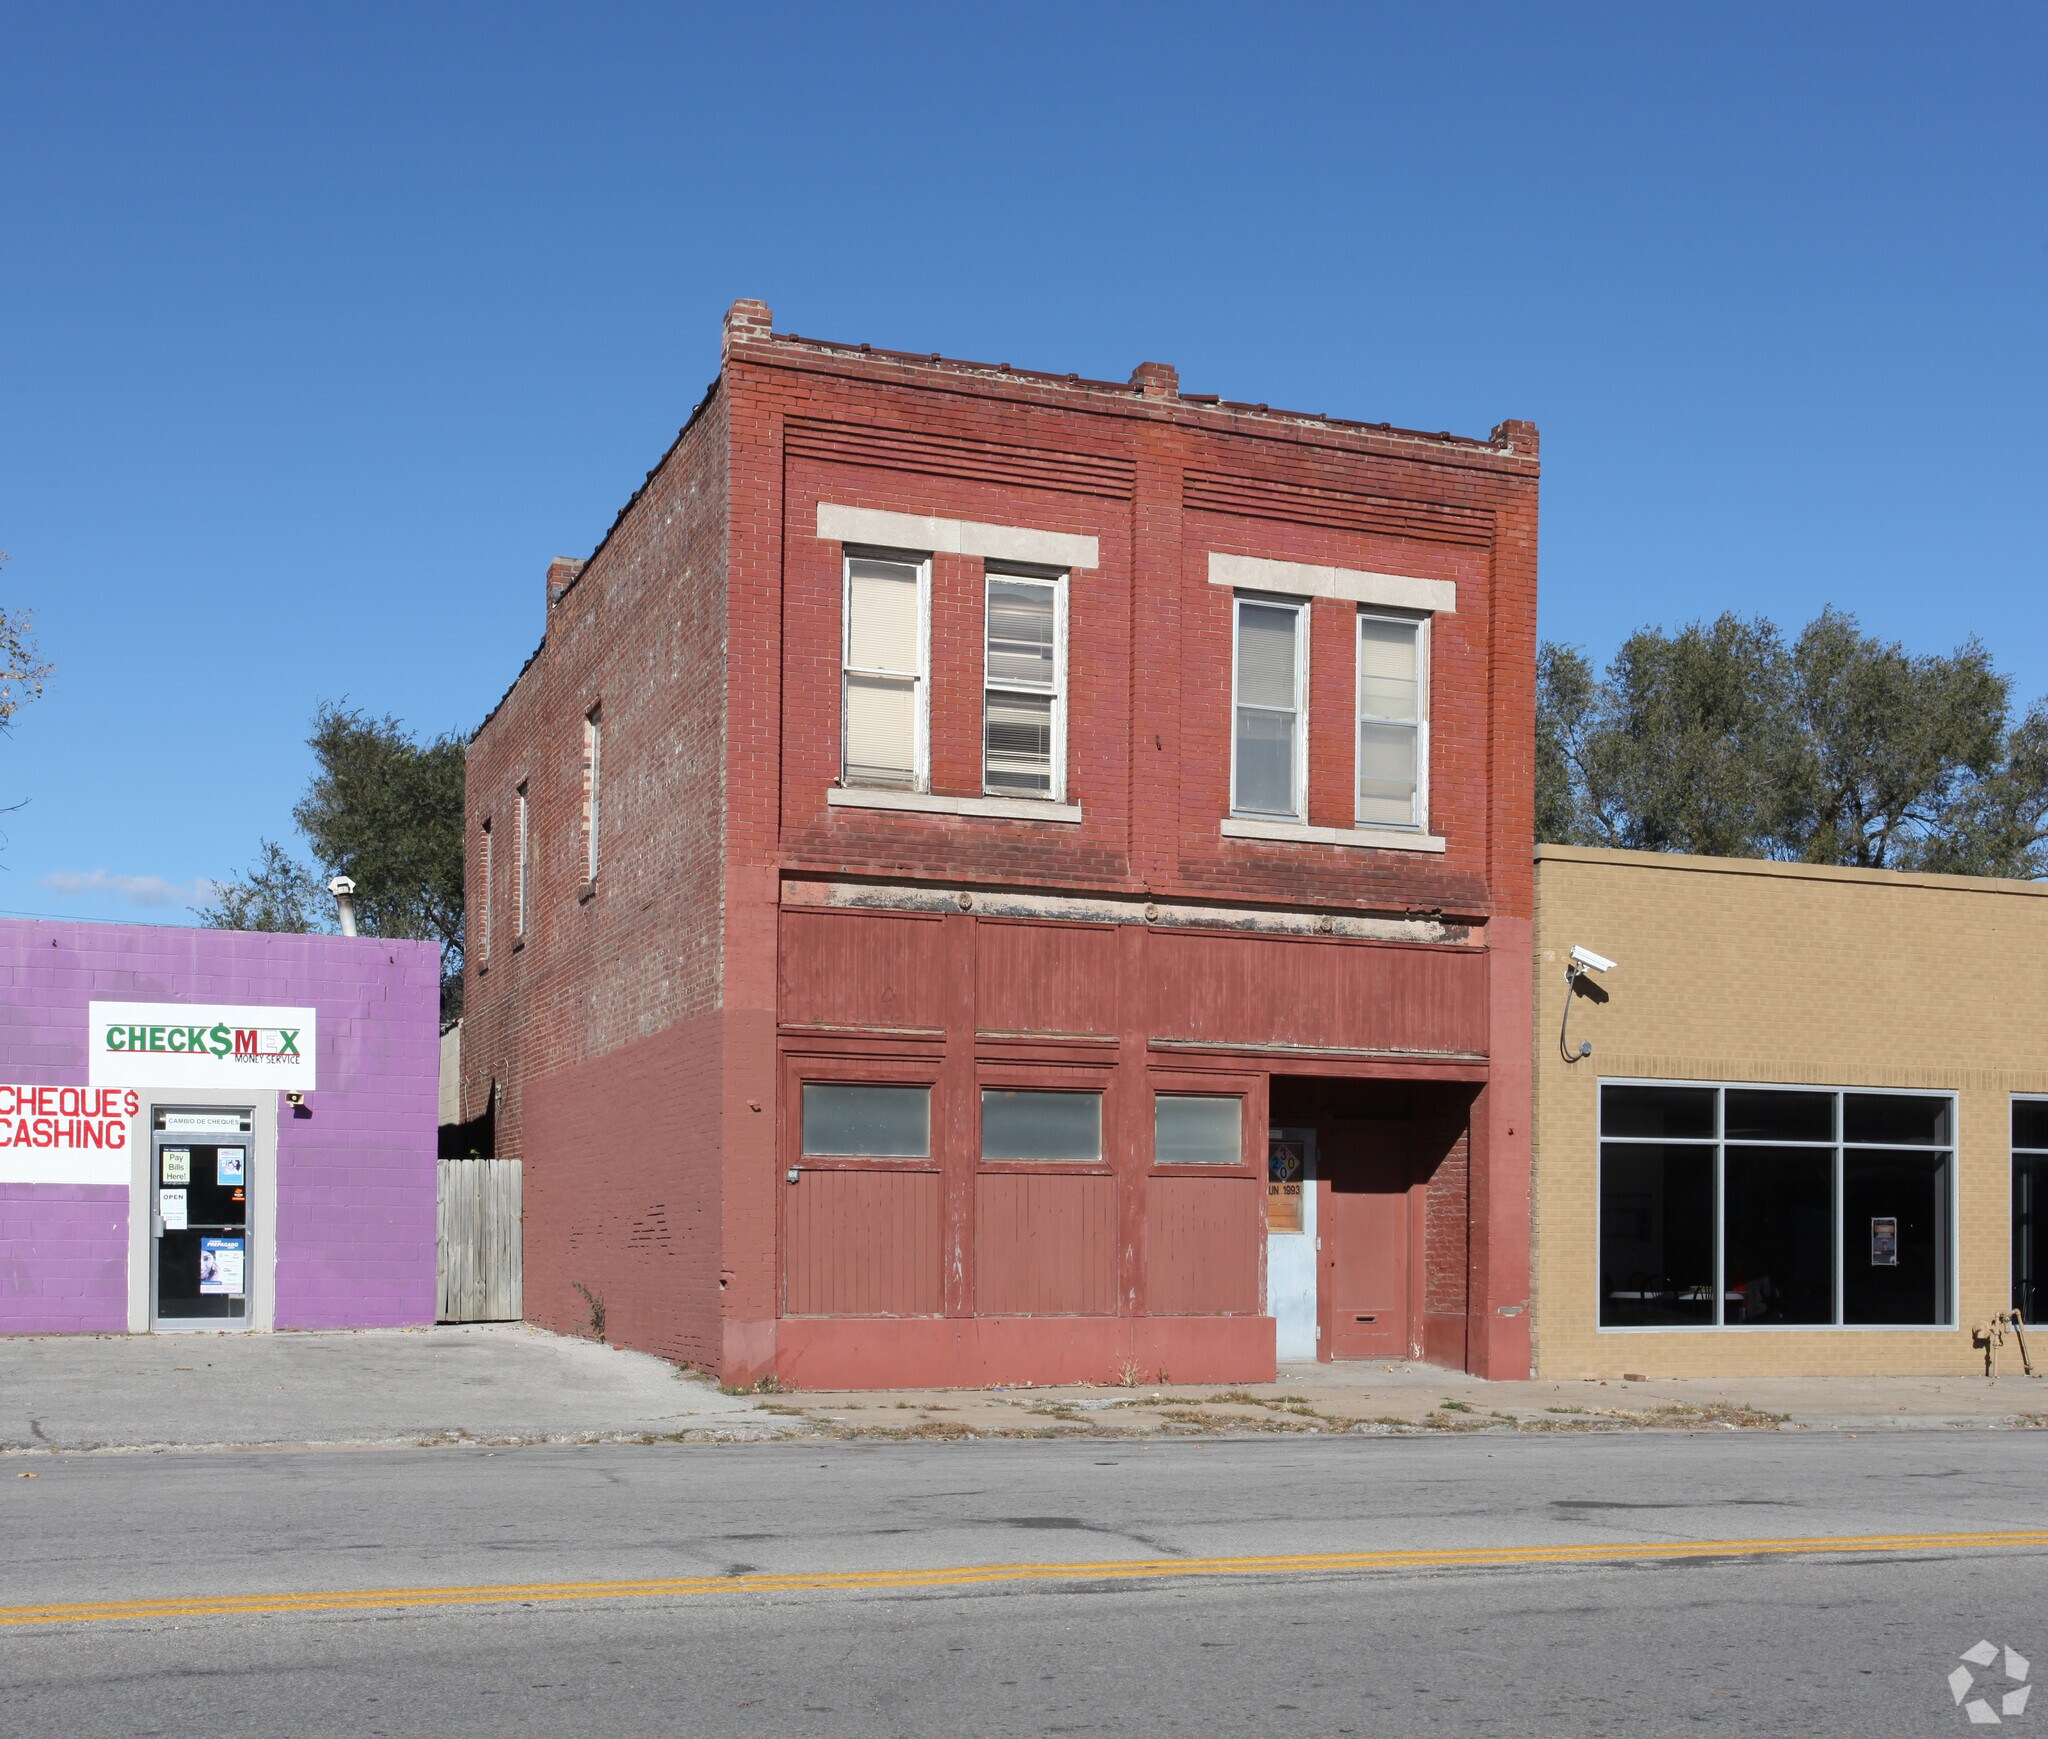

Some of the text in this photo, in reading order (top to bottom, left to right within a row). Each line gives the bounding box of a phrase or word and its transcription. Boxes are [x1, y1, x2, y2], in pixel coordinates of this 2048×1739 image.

[234, 1054, 300, 1064] MONEY SERVICE
[207, 1118, 240, 1126] CHEQUES
[0, 1118, 126, 1149] CASHING
[169, 1153, 184, 1162] Pay
[1280, 1149, 1287, 1161] 3
[169, 1163, 184, 1171] Bills
[1273, 1157, 1294, 1169] 2 0
[1280, 1166, 1287, 1179] 0
[1269, 1185, 1300, 1195] UN 1993
